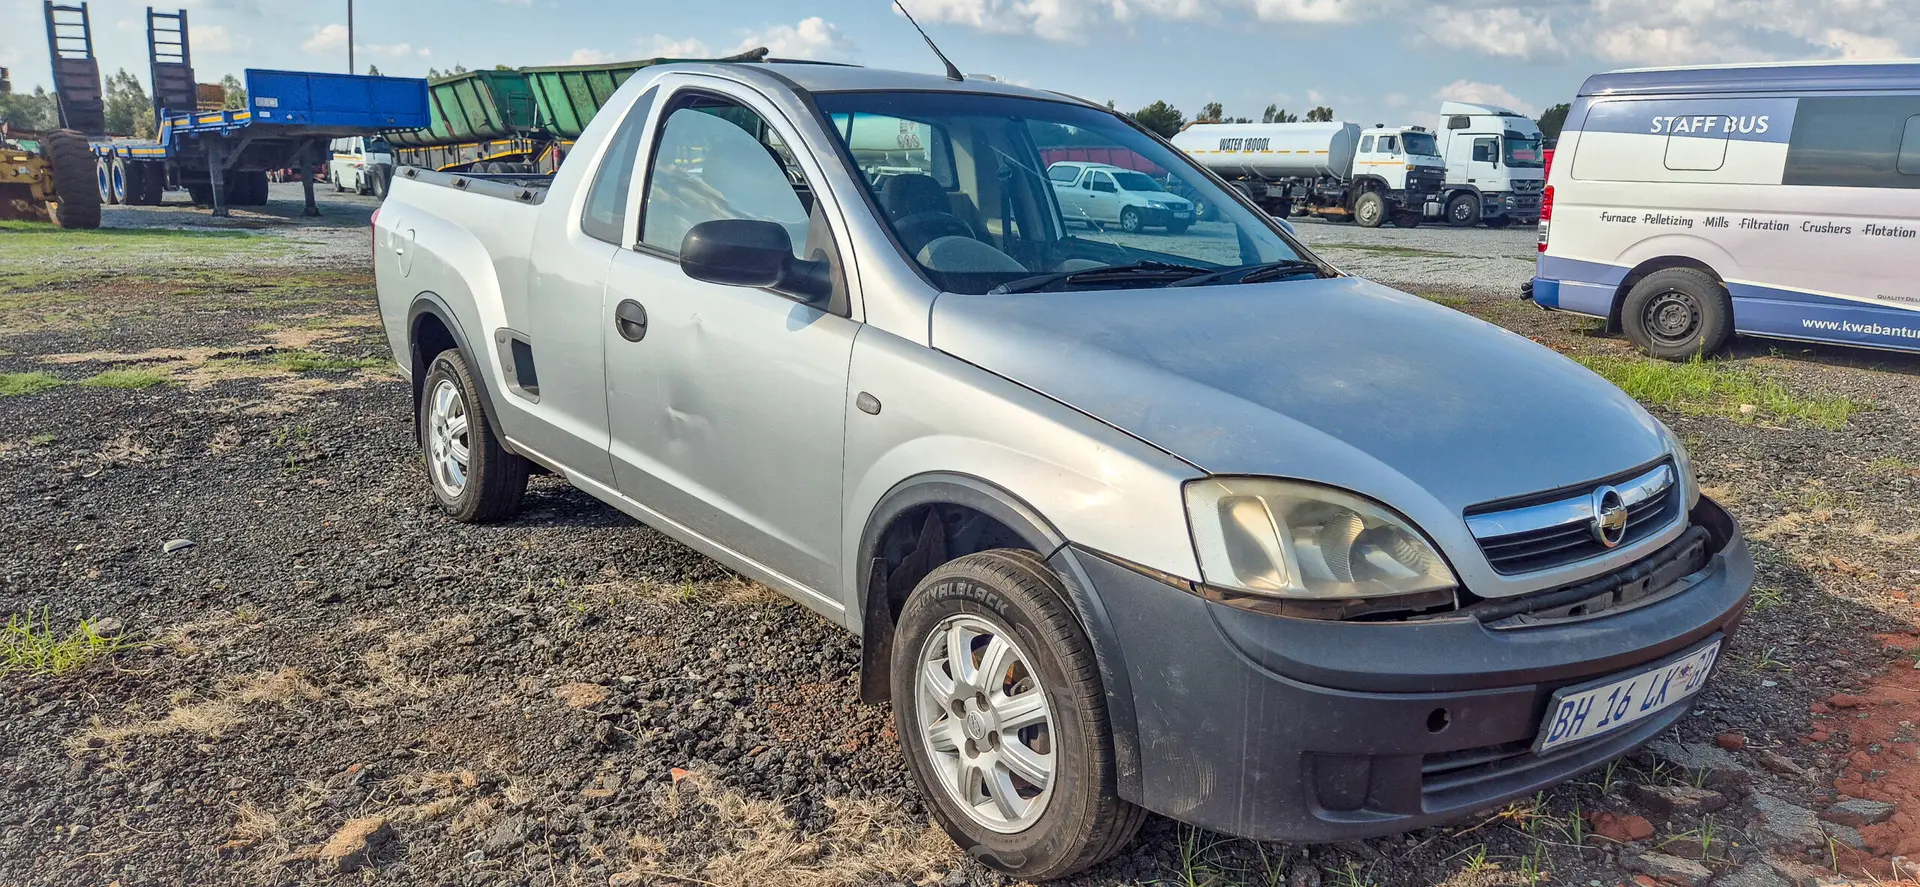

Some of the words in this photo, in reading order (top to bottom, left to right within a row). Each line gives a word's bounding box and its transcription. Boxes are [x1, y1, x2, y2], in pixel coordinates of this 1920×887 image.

[1650, 116, 1718, 134] STAFF
[1723, 115, 1769, 134] BUS
[1219, 137, 1243, 151] WATER
[1244, 137, 1271, 151] 18000L
[1549, 695, 1596, 743] BH
[1597, 681, 1637, 728] 16
[1640, 665, 1681, 713] LK
